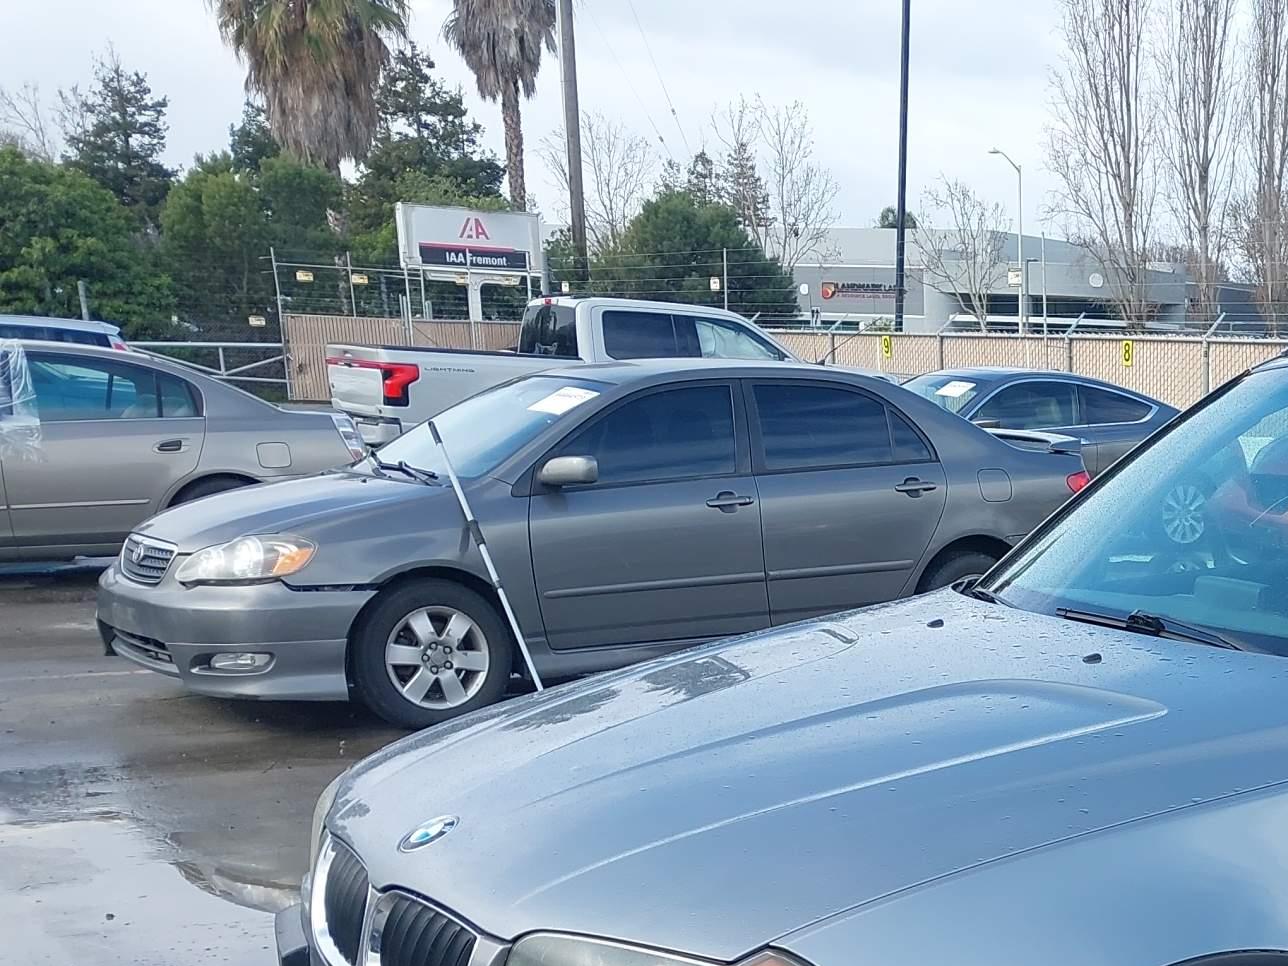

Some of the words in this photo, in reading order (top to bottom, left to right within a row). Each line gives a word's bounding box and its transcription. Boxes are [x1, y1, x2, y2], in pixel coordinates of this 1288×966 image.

[446, 252, 465, 263] IAA
[467, 254, 508, 266] Fremont
[883, 337, 890, 354] 9
[1123, 342, 1131, 362] 8
